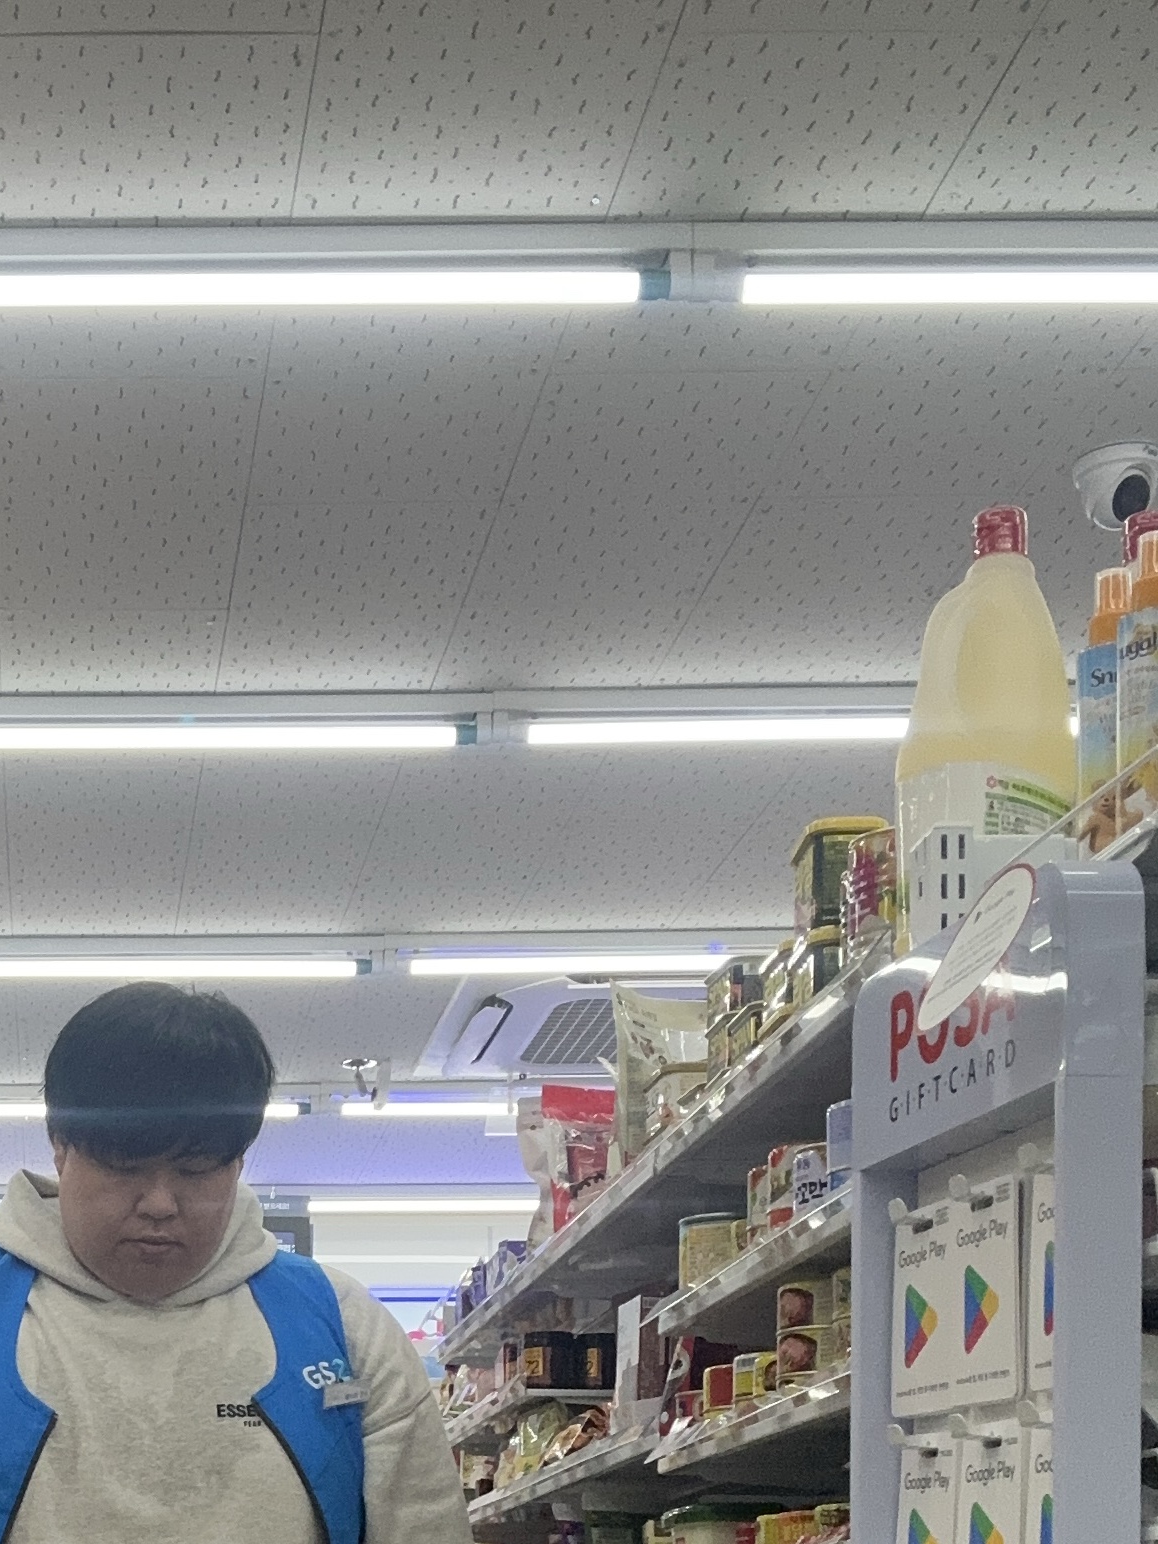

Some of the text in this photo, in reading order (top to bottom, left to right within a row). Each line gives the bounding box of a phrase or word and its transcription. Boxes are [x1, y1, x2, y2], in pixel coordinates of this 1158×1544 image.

[956, 1218, 1008, 1248] Google Play
[898, 1240, 947, 1269] Google Play
[216, 1404, 261, 1418] ESSE
[904, 1471, 950, 1494] Google Play
[965, 1460, 1016, 1487] Google Play
